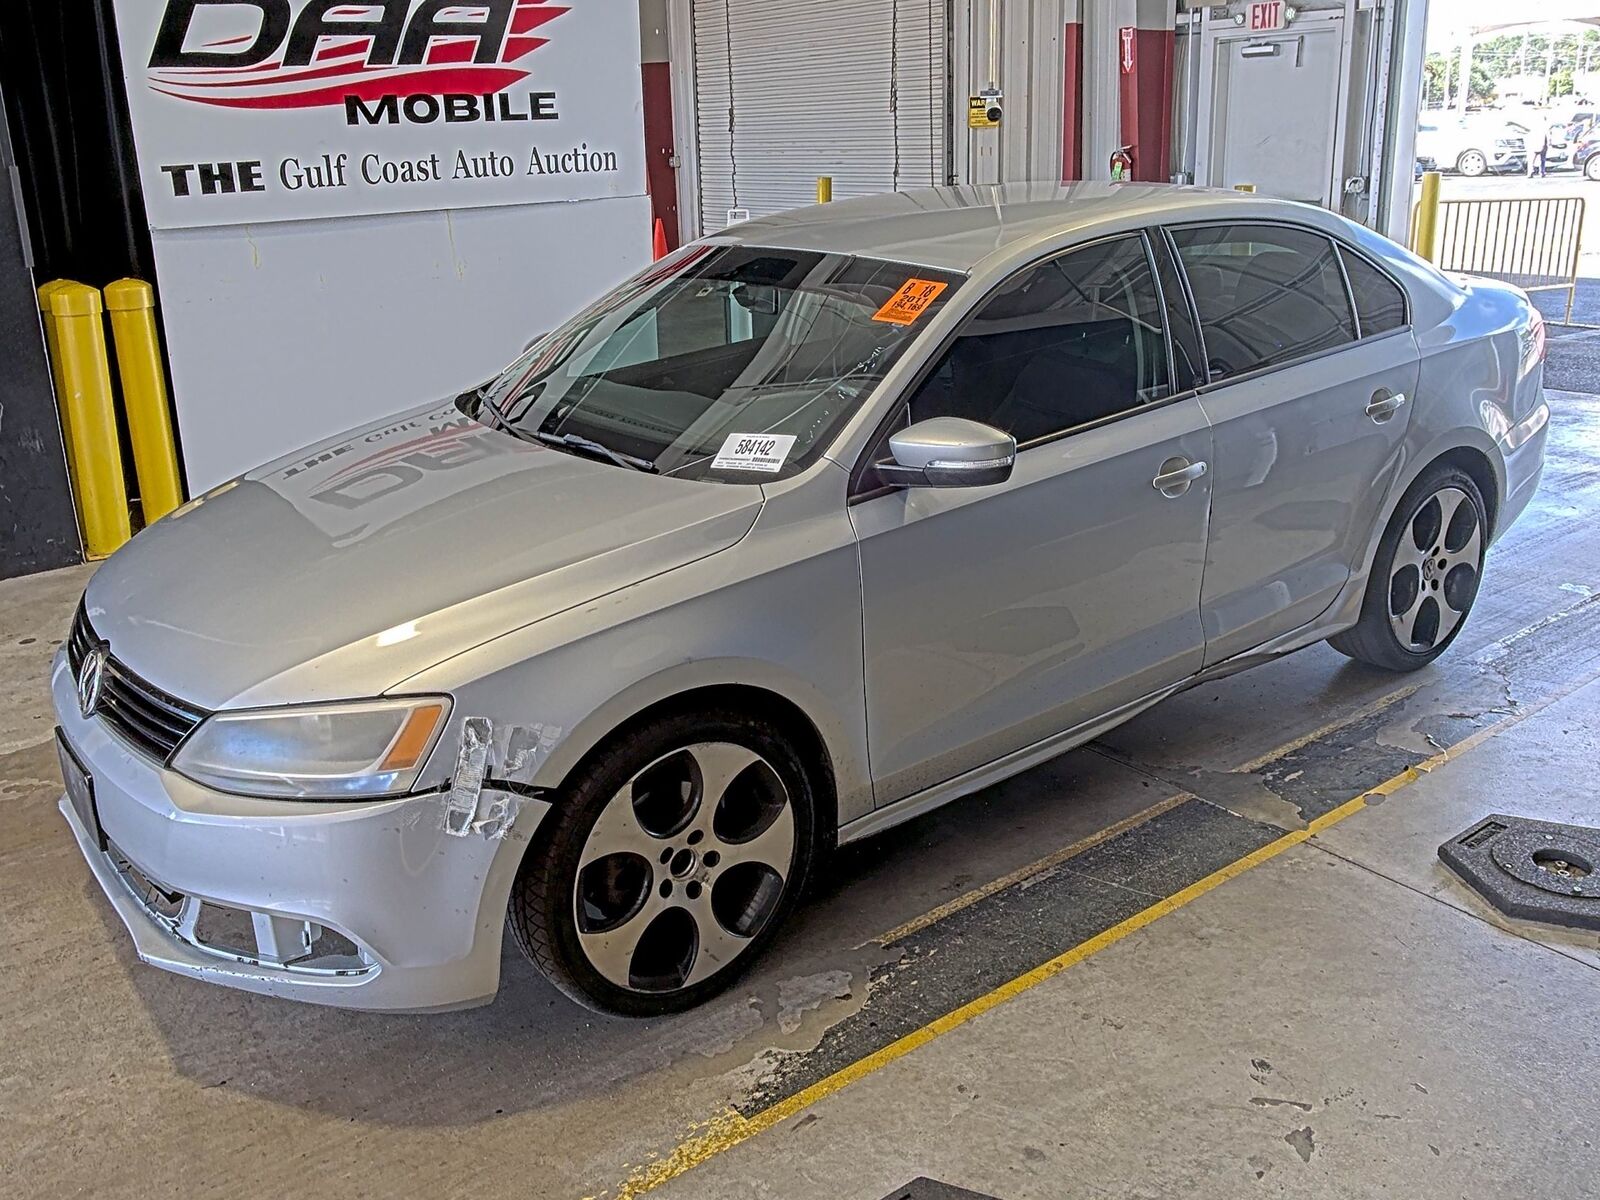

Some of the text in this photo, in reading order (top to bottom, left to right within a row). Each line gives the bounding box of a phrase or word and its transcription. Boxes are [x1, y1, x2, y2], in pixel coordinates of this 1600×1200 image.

[1252, 2, 1280, 29] EXIT
[147, 0, 515, 68] DAA
[344, 91, 559, 125] MOBILE
[160, 142, 618, 197] THE Gulf Coast Auto Auction
[900, 294, 929, 306] 2011
[919, 284, 937, 298] 18
[735, 439, 776, 456] 584142
